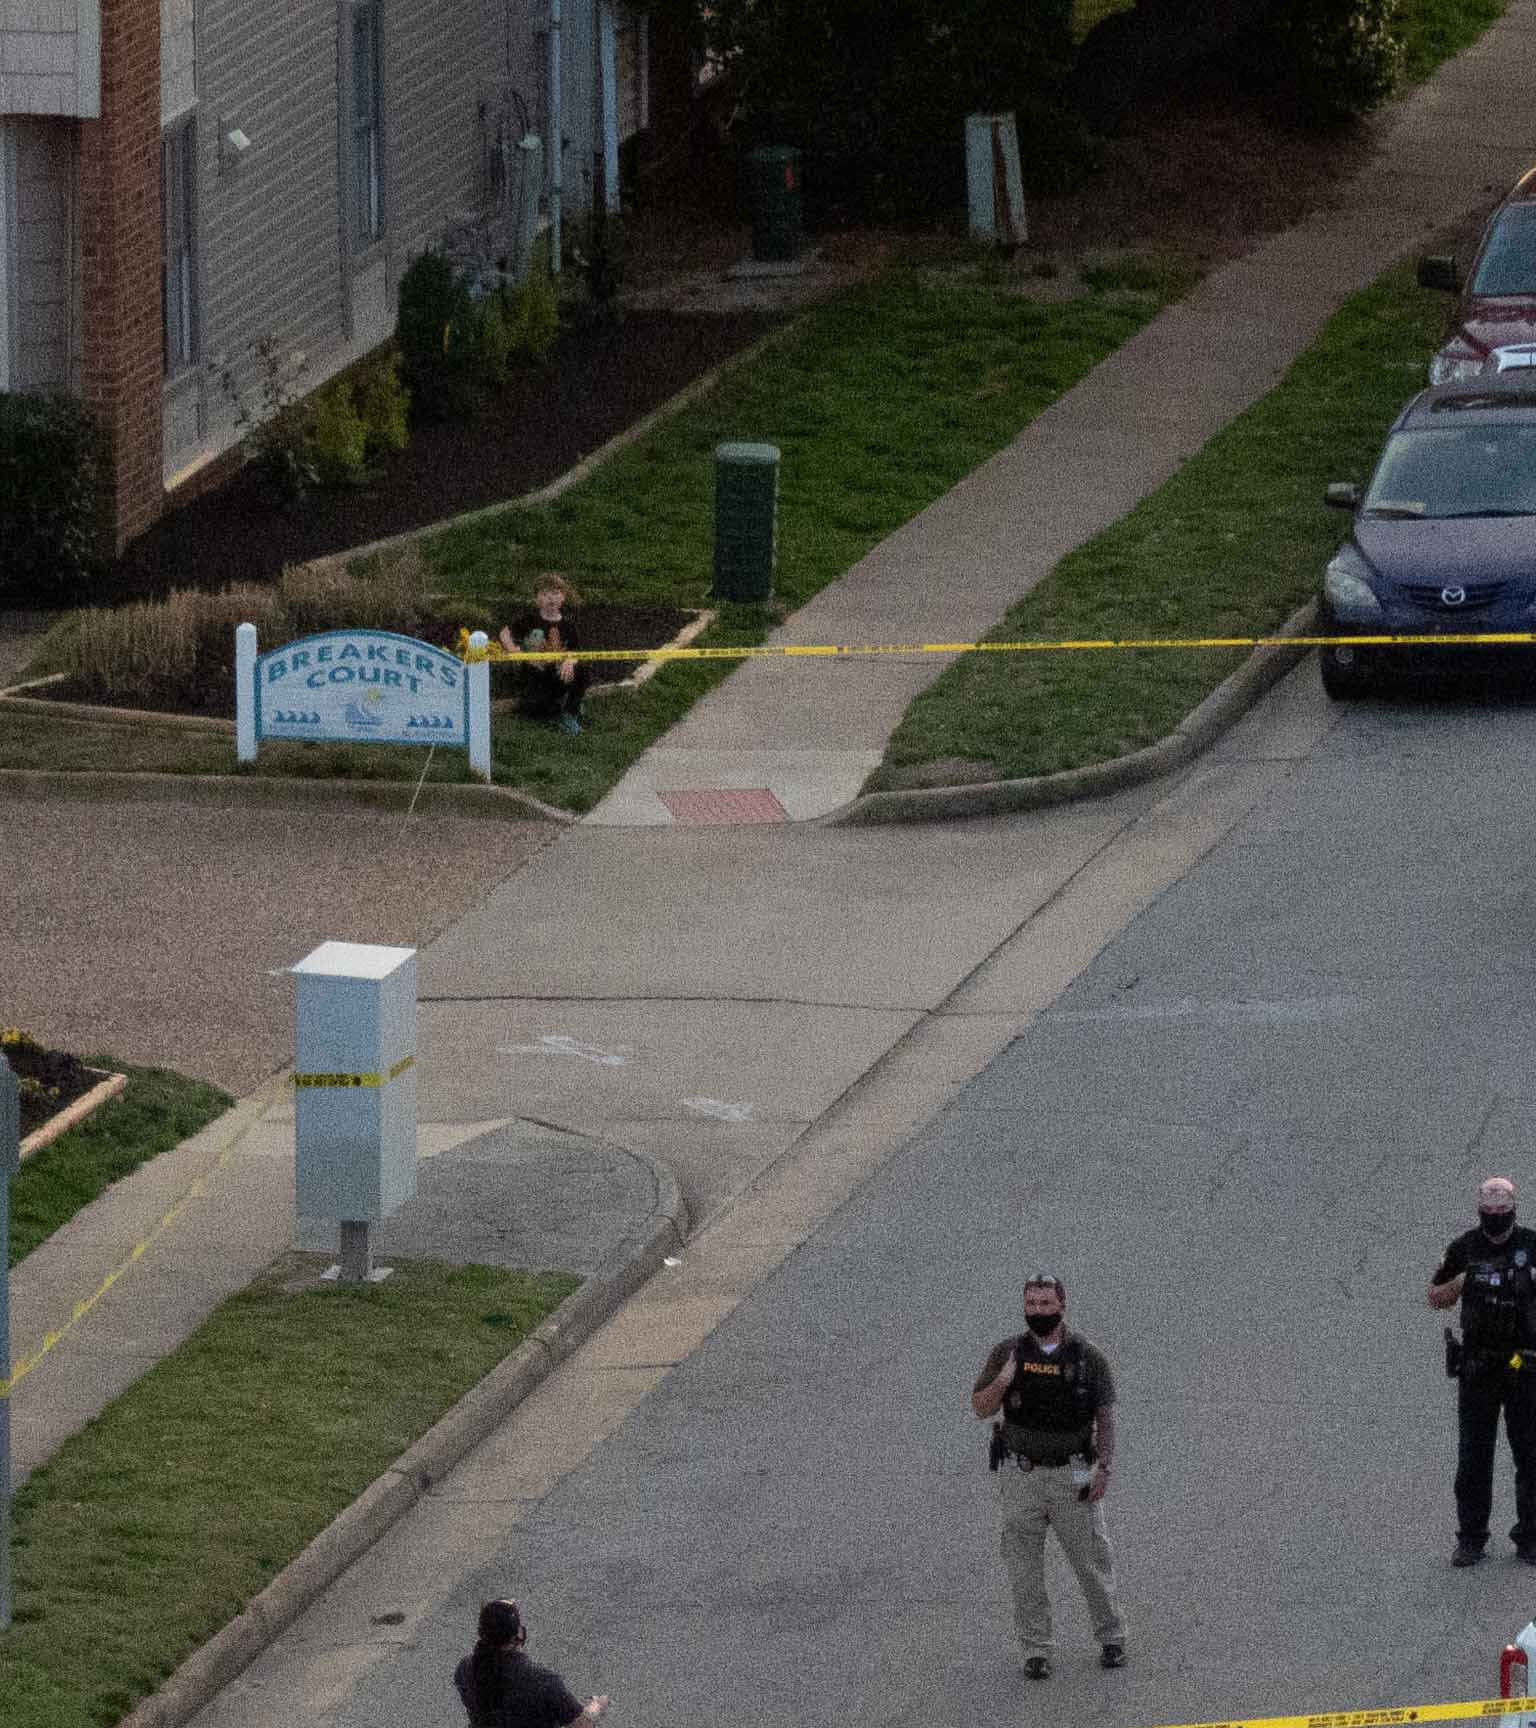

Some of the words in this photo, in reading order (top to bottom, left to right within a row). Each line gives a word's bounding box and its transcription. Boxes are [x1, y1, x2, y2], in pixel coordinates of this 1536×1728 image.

[267, 643, 458, 688] BREAKERS
[306, 666, 421, 693] COURT
[1023, 1361, 1061, 1376] POLICE
